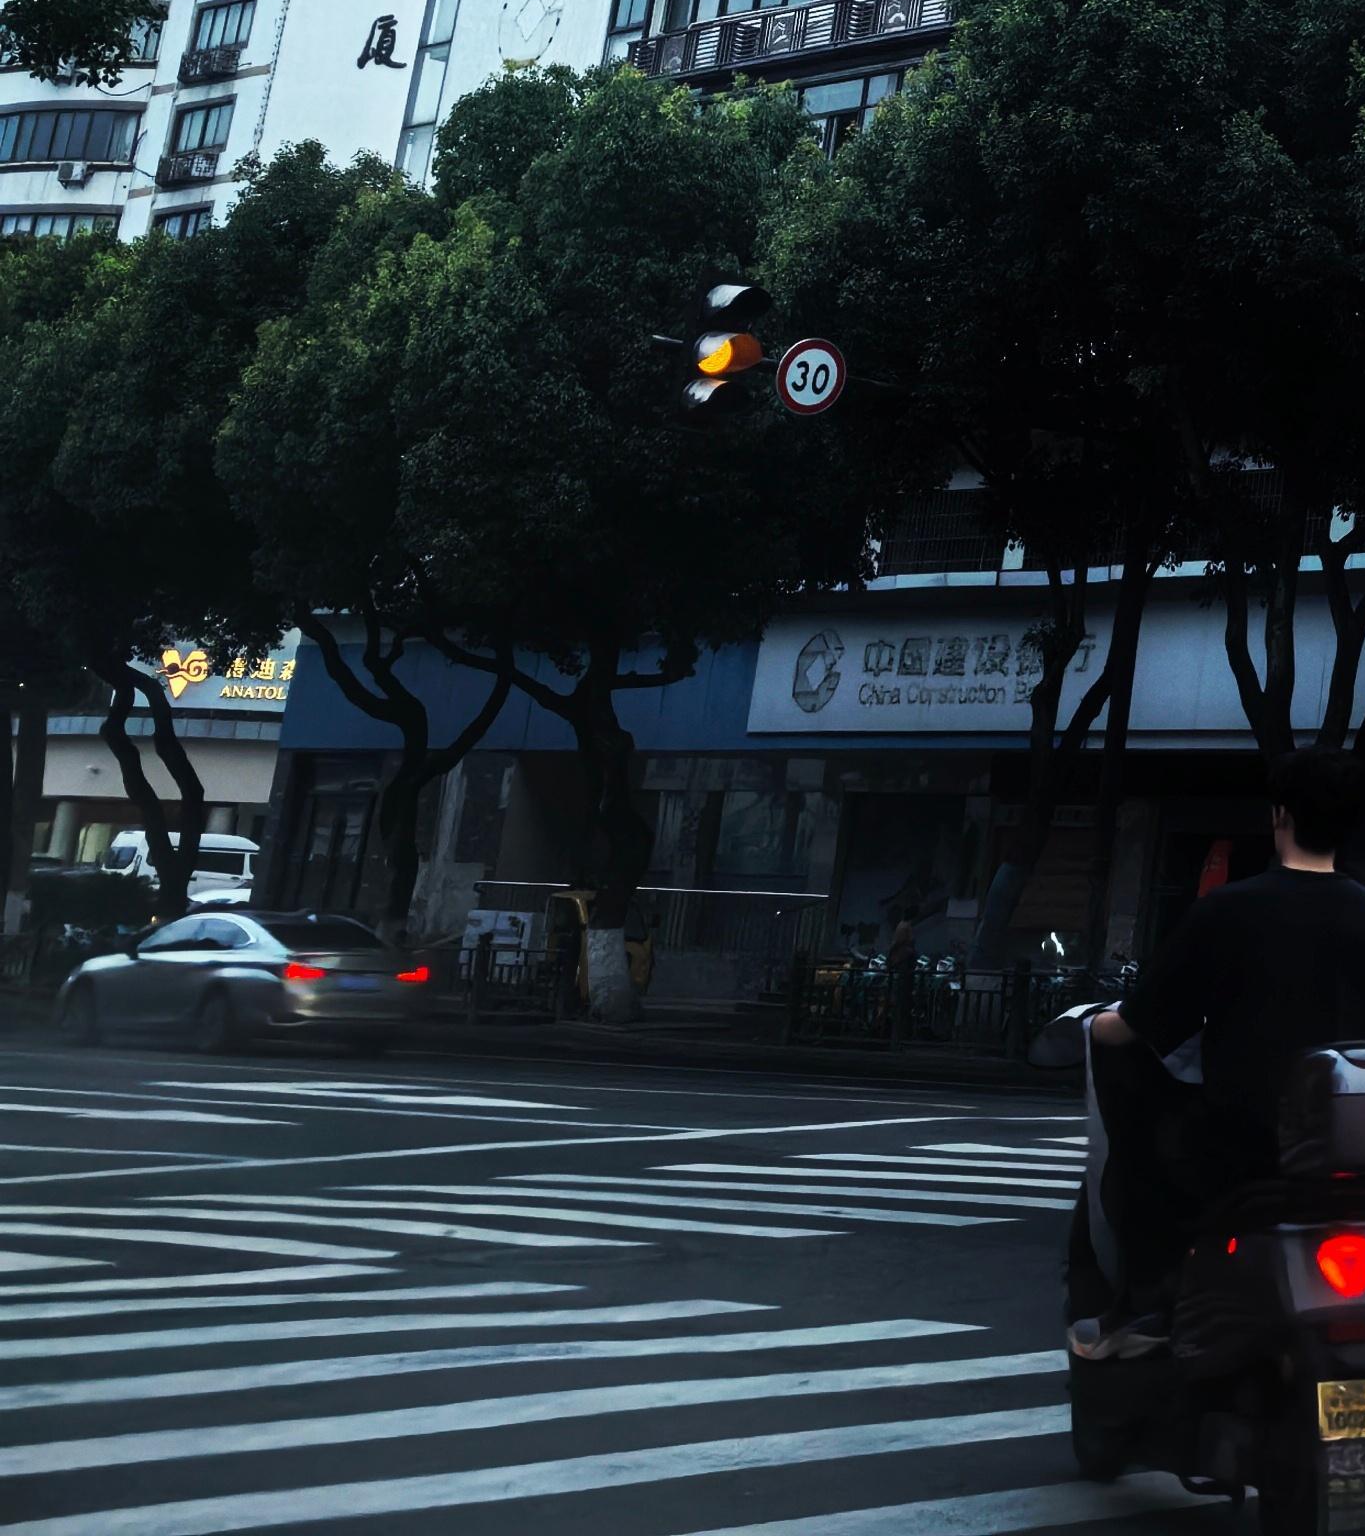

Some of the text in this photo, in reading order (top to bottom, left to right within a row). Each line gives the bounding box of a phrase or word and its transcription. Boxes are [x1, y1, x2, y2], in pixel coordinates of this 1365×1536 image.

[791, 360, 830, 395] 30
[219, 685, 287, 700] ANATOL
[858, 682, 901, 706] China
[906, 683, 1006, 706] Construction
